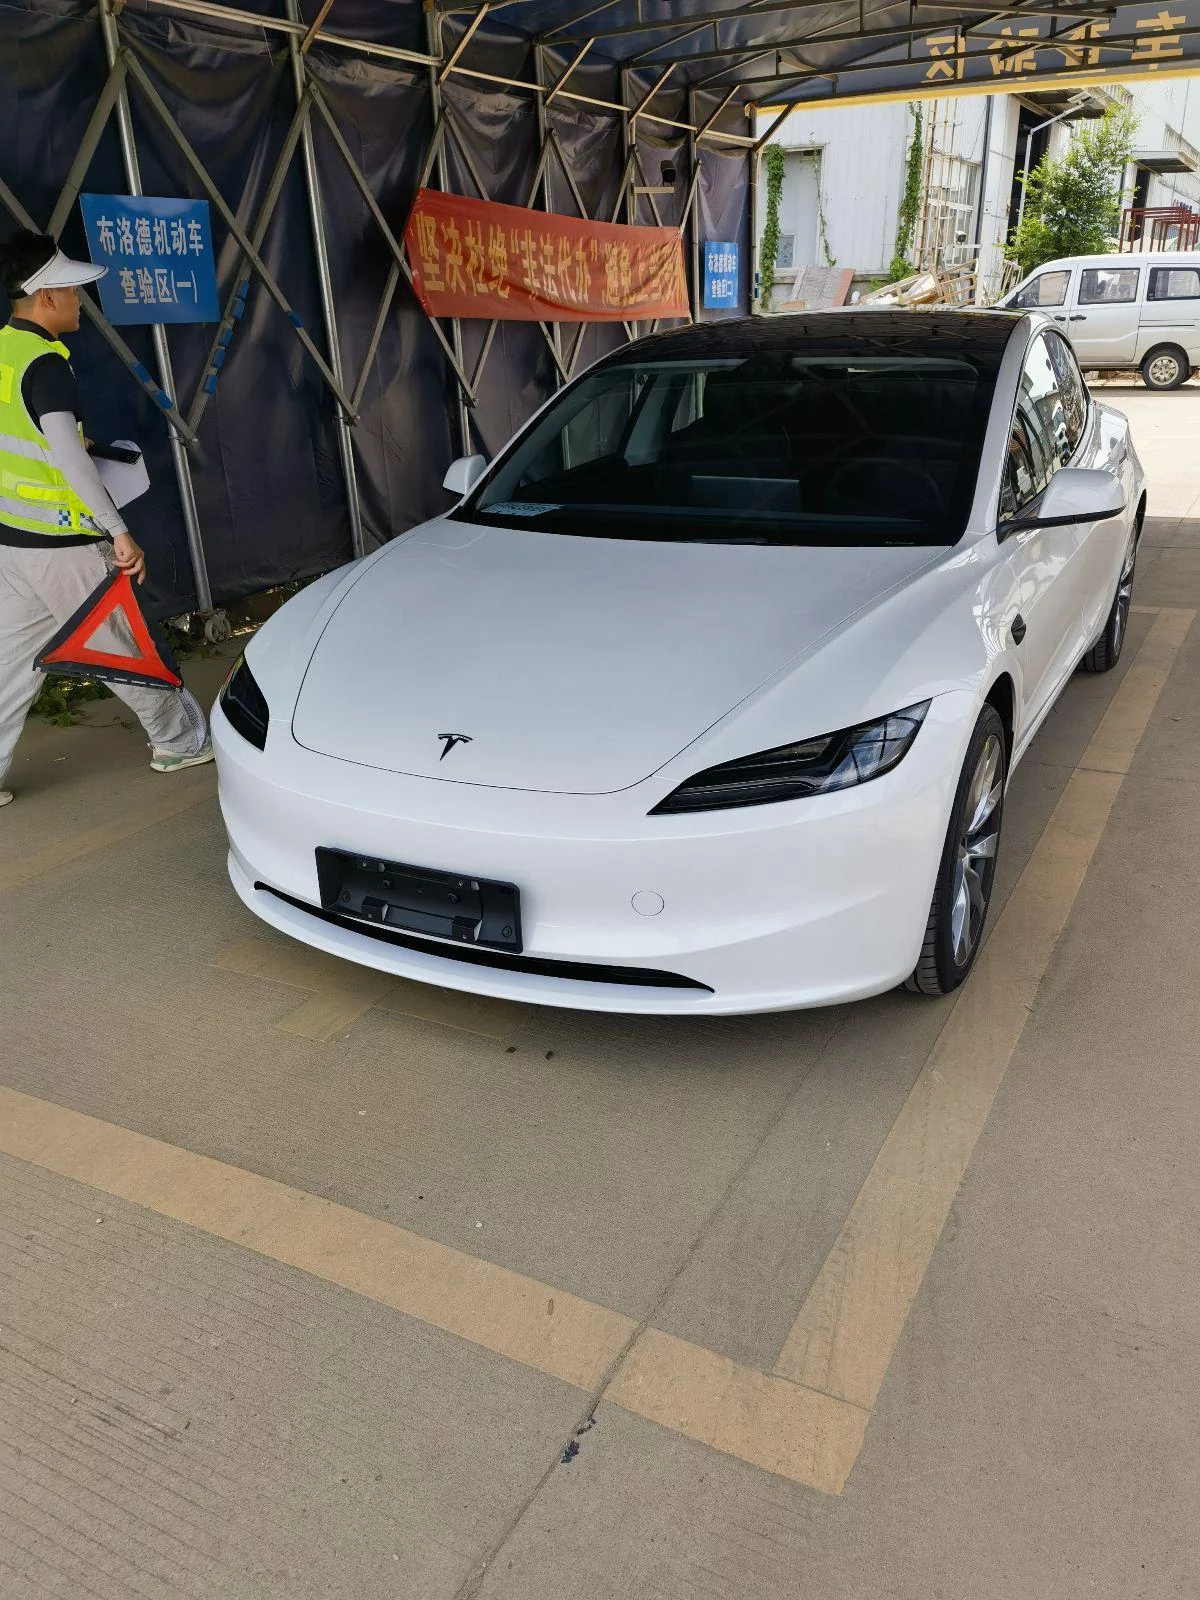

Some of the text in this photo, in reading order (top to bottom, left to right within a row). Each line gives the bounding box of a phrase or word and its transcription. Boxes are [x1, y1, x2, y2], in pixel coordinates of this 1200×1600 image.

[97, 215, 204, 256] 布洛德机动车
